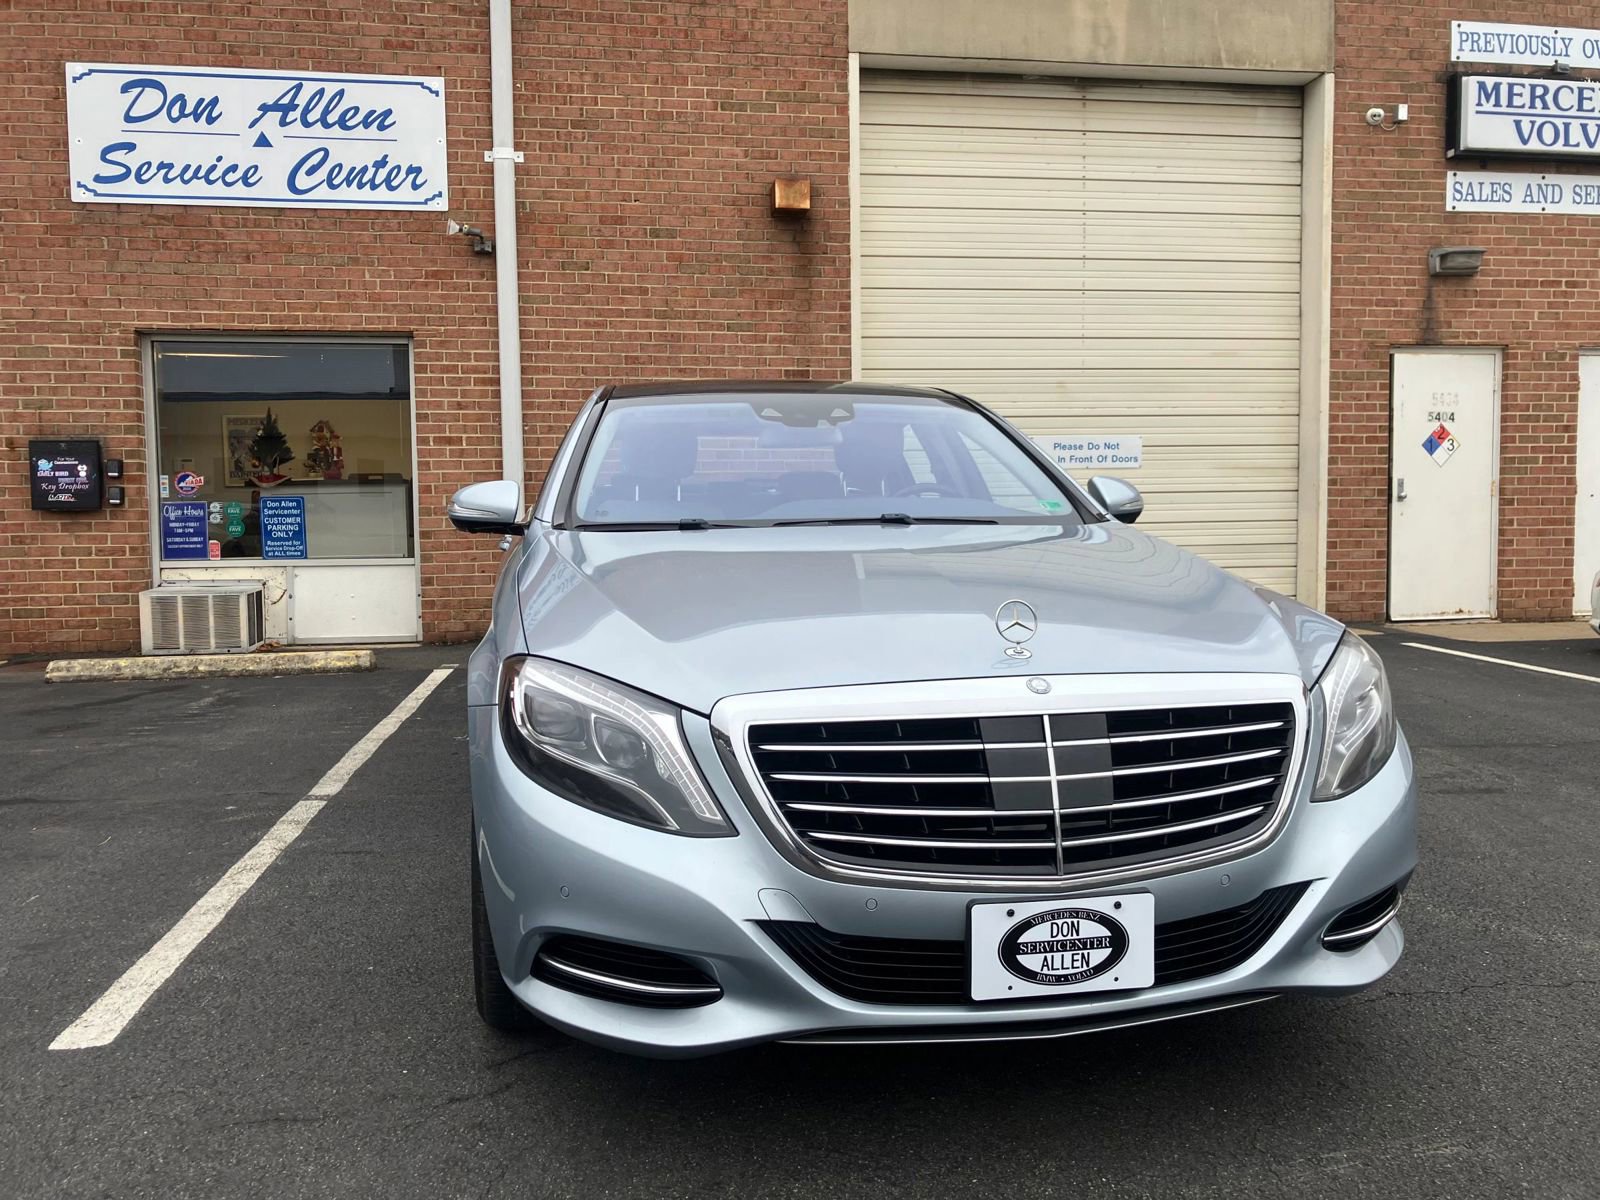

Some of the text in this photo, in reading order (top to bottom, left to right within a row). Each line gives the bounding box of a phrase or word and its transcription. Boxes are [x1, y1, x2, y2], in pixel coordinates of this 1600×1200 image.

[1458, 31, 1573, 58] PREVIOUSLY
[119, 78, 397, 131] Don Allen
[1475, 80, 1600, 113] MERCE
[1513, 119, 1600, 149] VOLV
[92, 141, 428, 196] Service Center
[1452, 181, 1513, 204] SALES
[1522, 183, 1563, 204] AND
[1428, 411, 1455, 422] 5404
[1437, 425, 1445, 439] 2
[1053, 442, 1120, 451] Please Do Not
[1447, 438, 1455, 451] 3
[1057, 454, 1139, 463] In Front Of Doors
[41, 481, 90, 493] Key Dropbox
[163, 505, 204, 521] Office Hours
[1030, 911, 1101, 926] MERCEDES BENZ
[1051, 920, 1080, 938] DON
[1019, 937, 1110, 954] SERVICENTER
[1040, 952, 1090, 972] ALLEN
[1036, 969, 1094, 982] BMW VOLVO
